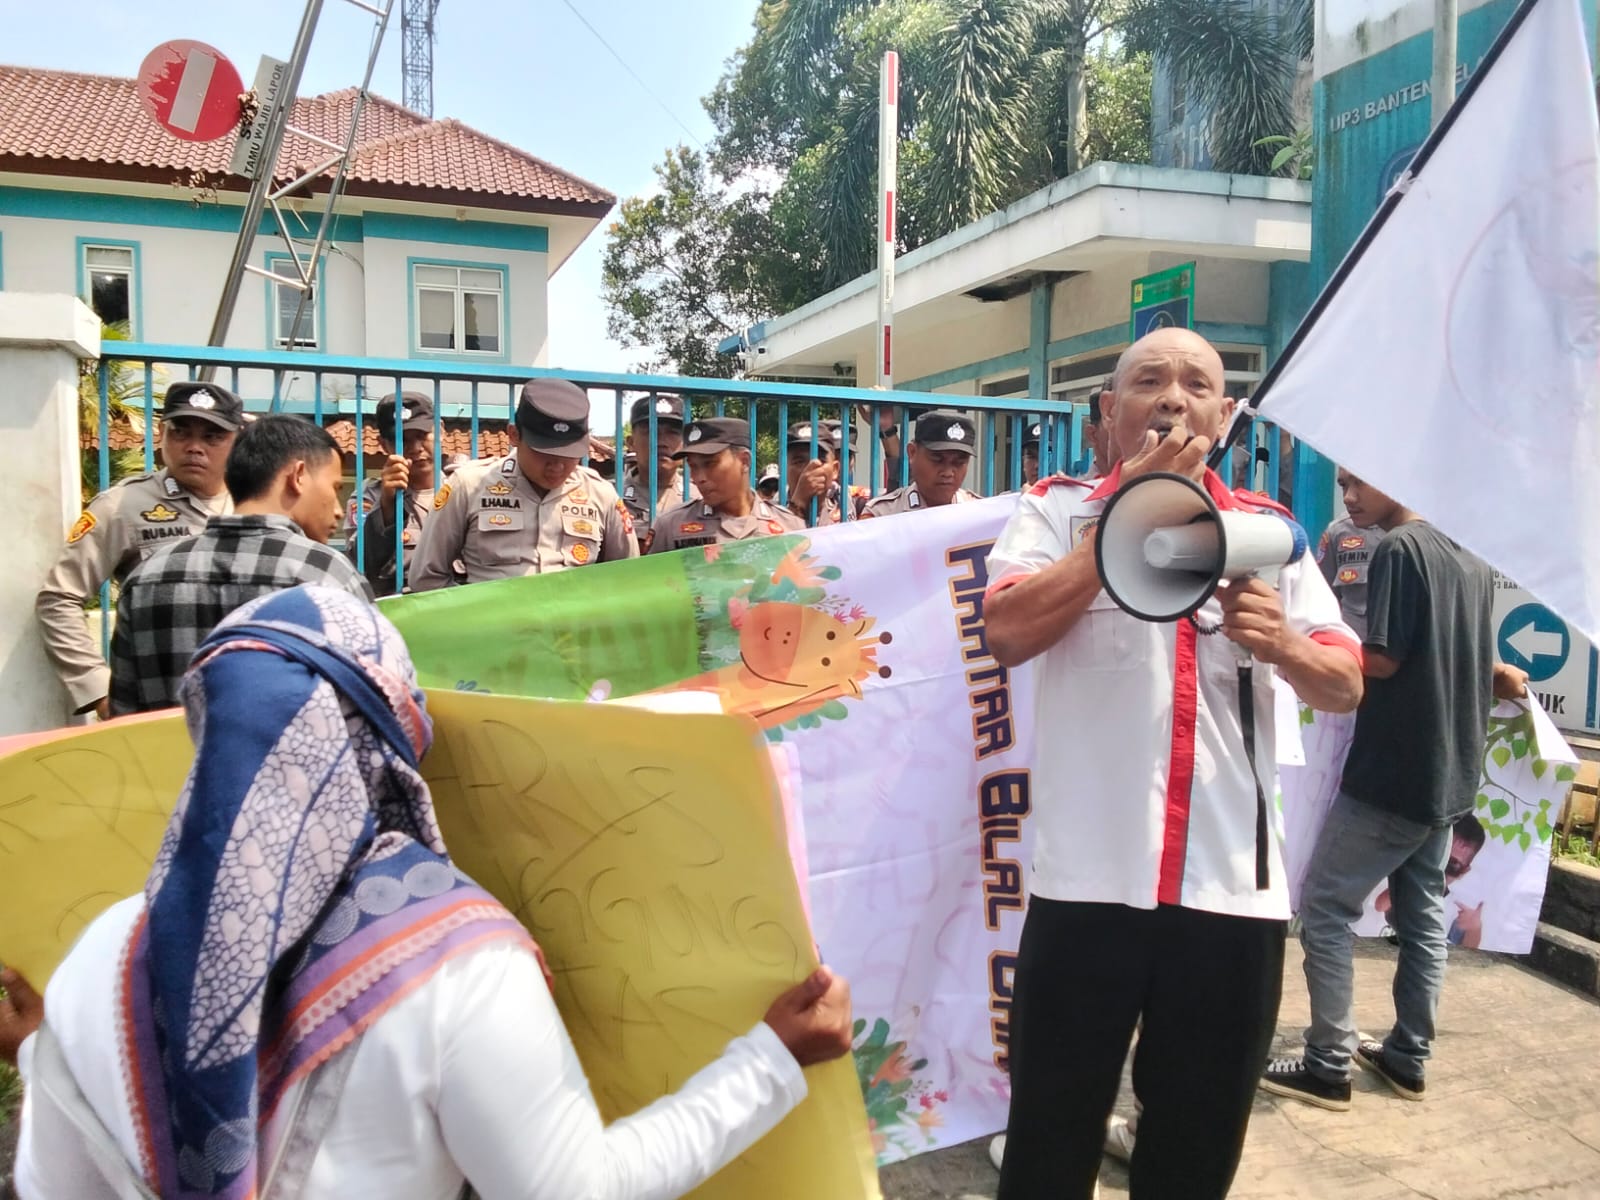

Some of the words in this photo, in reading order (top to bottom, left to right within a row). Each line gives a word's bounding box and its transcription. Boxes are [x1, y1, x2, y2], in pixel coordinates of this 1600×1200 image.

[244, 142, 261, 174] TAMU
[254, 104, 273, 141] WAJIB
[265, 63, 284, 101] LAPOR
[1330, 108, 1361, 134] UP3
[561, 505, 597, 519] POLRI
[977, 767, 1032, 932] BILAL
